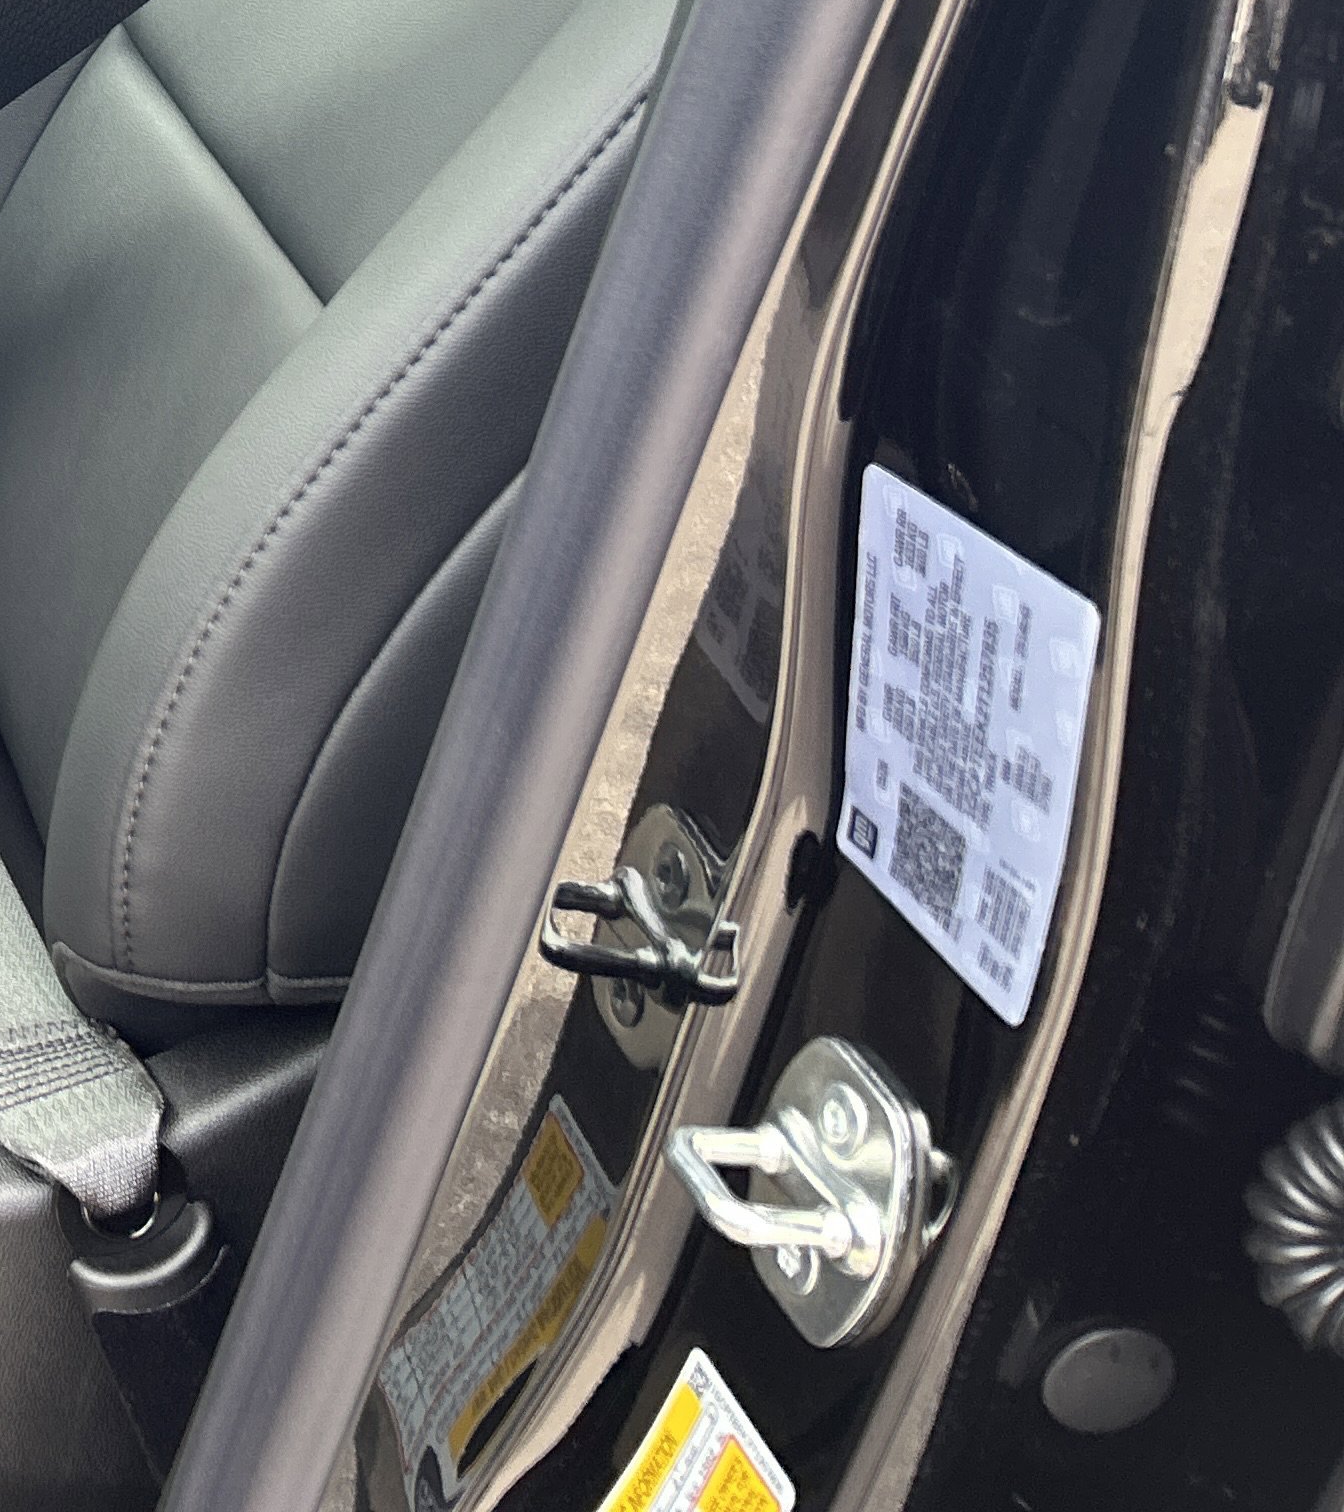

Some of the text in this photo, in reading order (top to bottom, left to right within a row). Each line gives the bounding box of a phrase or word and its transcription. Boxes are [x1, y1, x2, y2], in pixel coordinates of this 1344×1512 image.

[892, 526, 905, 568] GAWR
[917, 528, 928, 549] LB
[865, 549, 877, 578] LLC
[861, 574, 875, 630] MOTORS
[926, 581, 937, 609] ALL
[935, 579, 950, 628] MOTOR
[858, 628, 871, 688] GENERAL
[887, 617, 900, 659] GAWR
[857, 685, 867, 707] BY
[852, 810, 872, 855] gm
